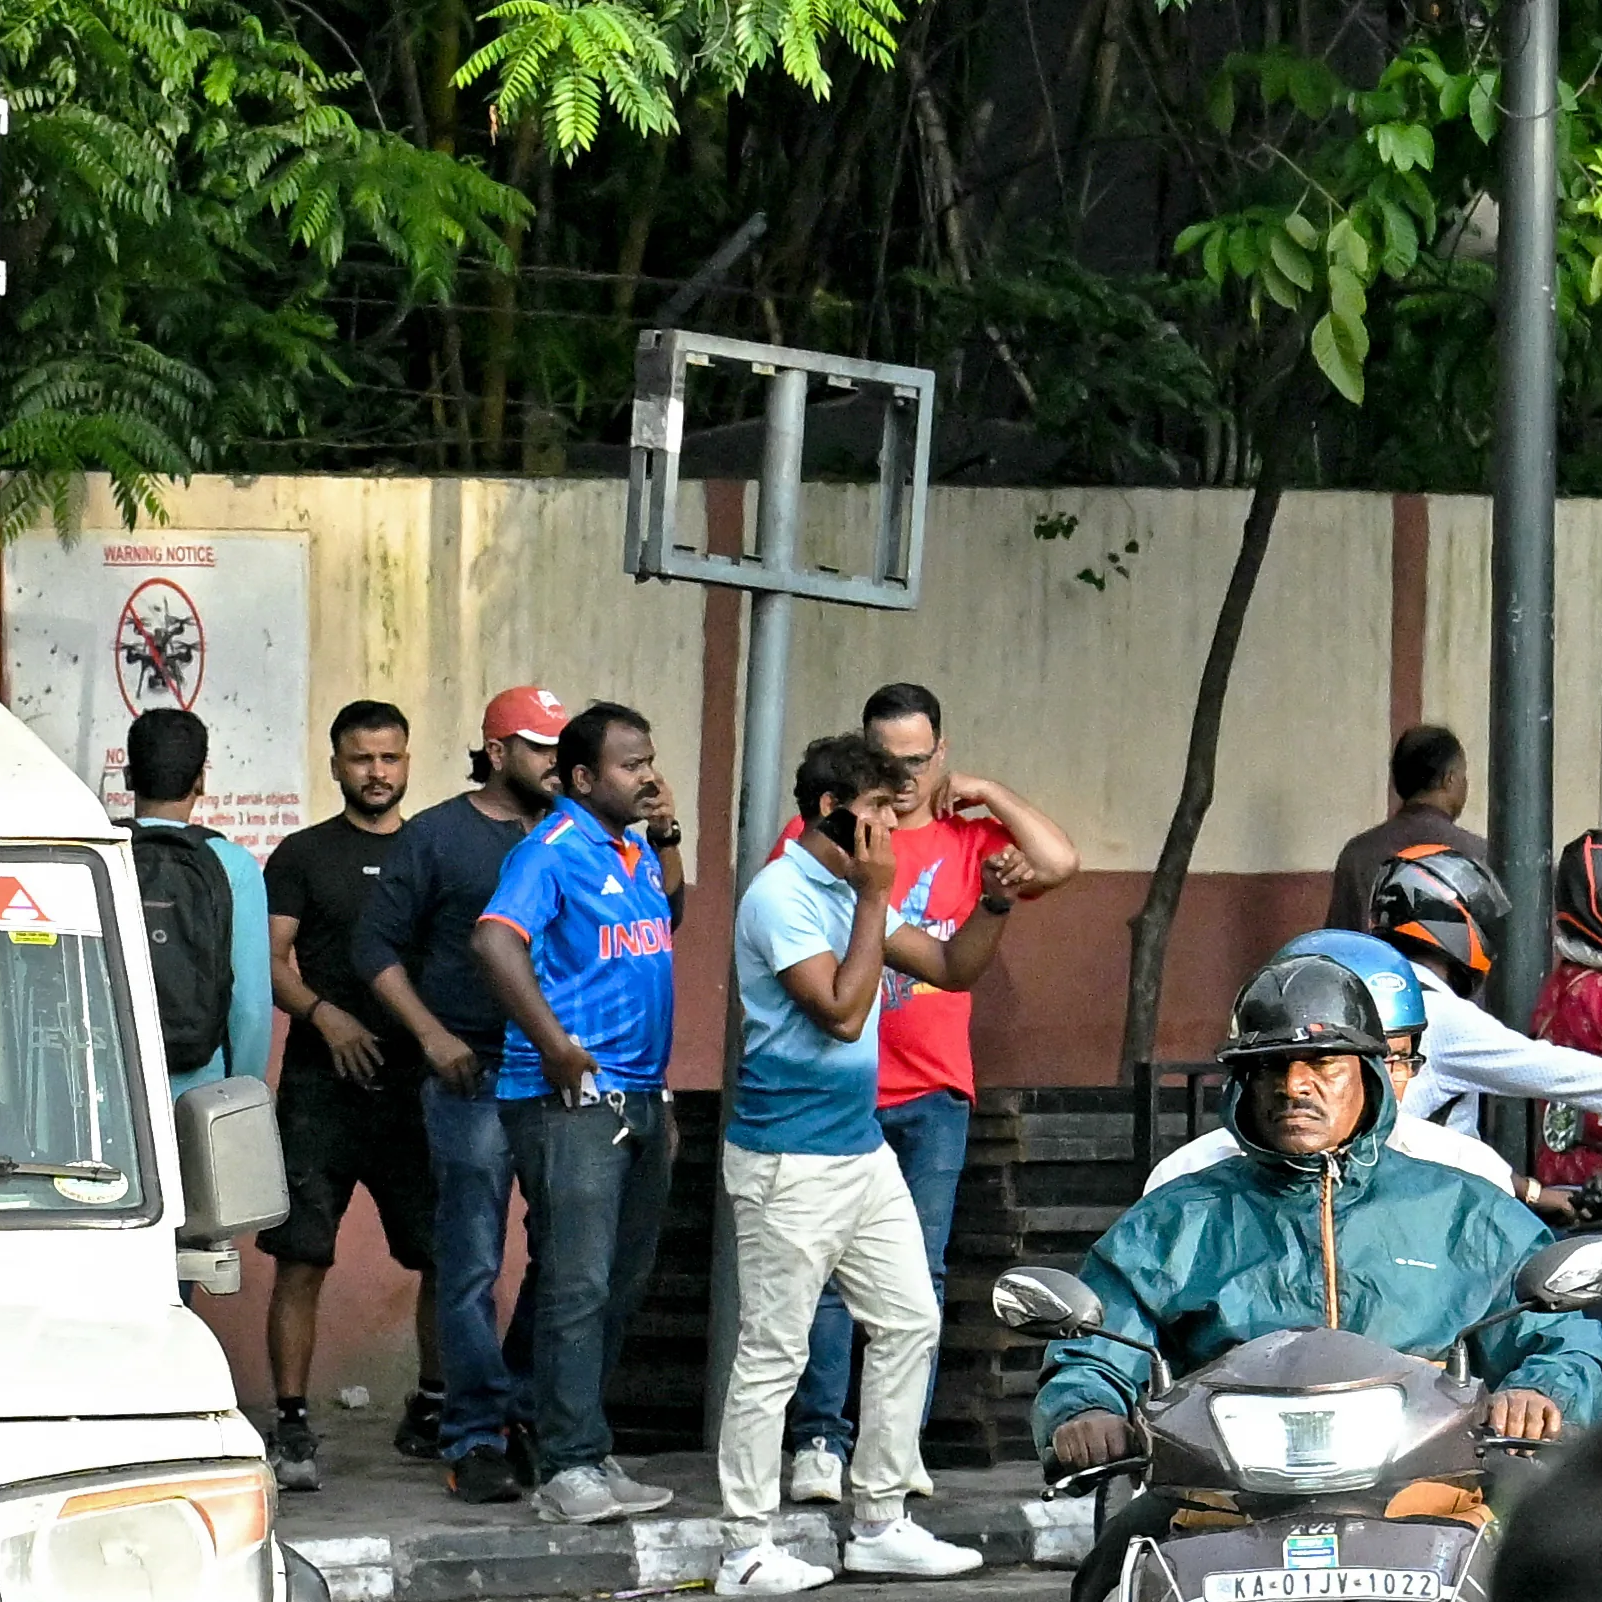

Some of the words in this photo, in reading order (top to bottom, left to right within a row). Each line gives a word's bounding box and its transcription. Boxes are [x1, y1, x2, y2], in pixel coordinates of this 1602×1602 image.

[104, 546, 162, 563] WARNING
[166, 546, 215, 562] NOTICE
[105, 748, 125, 763] NO
